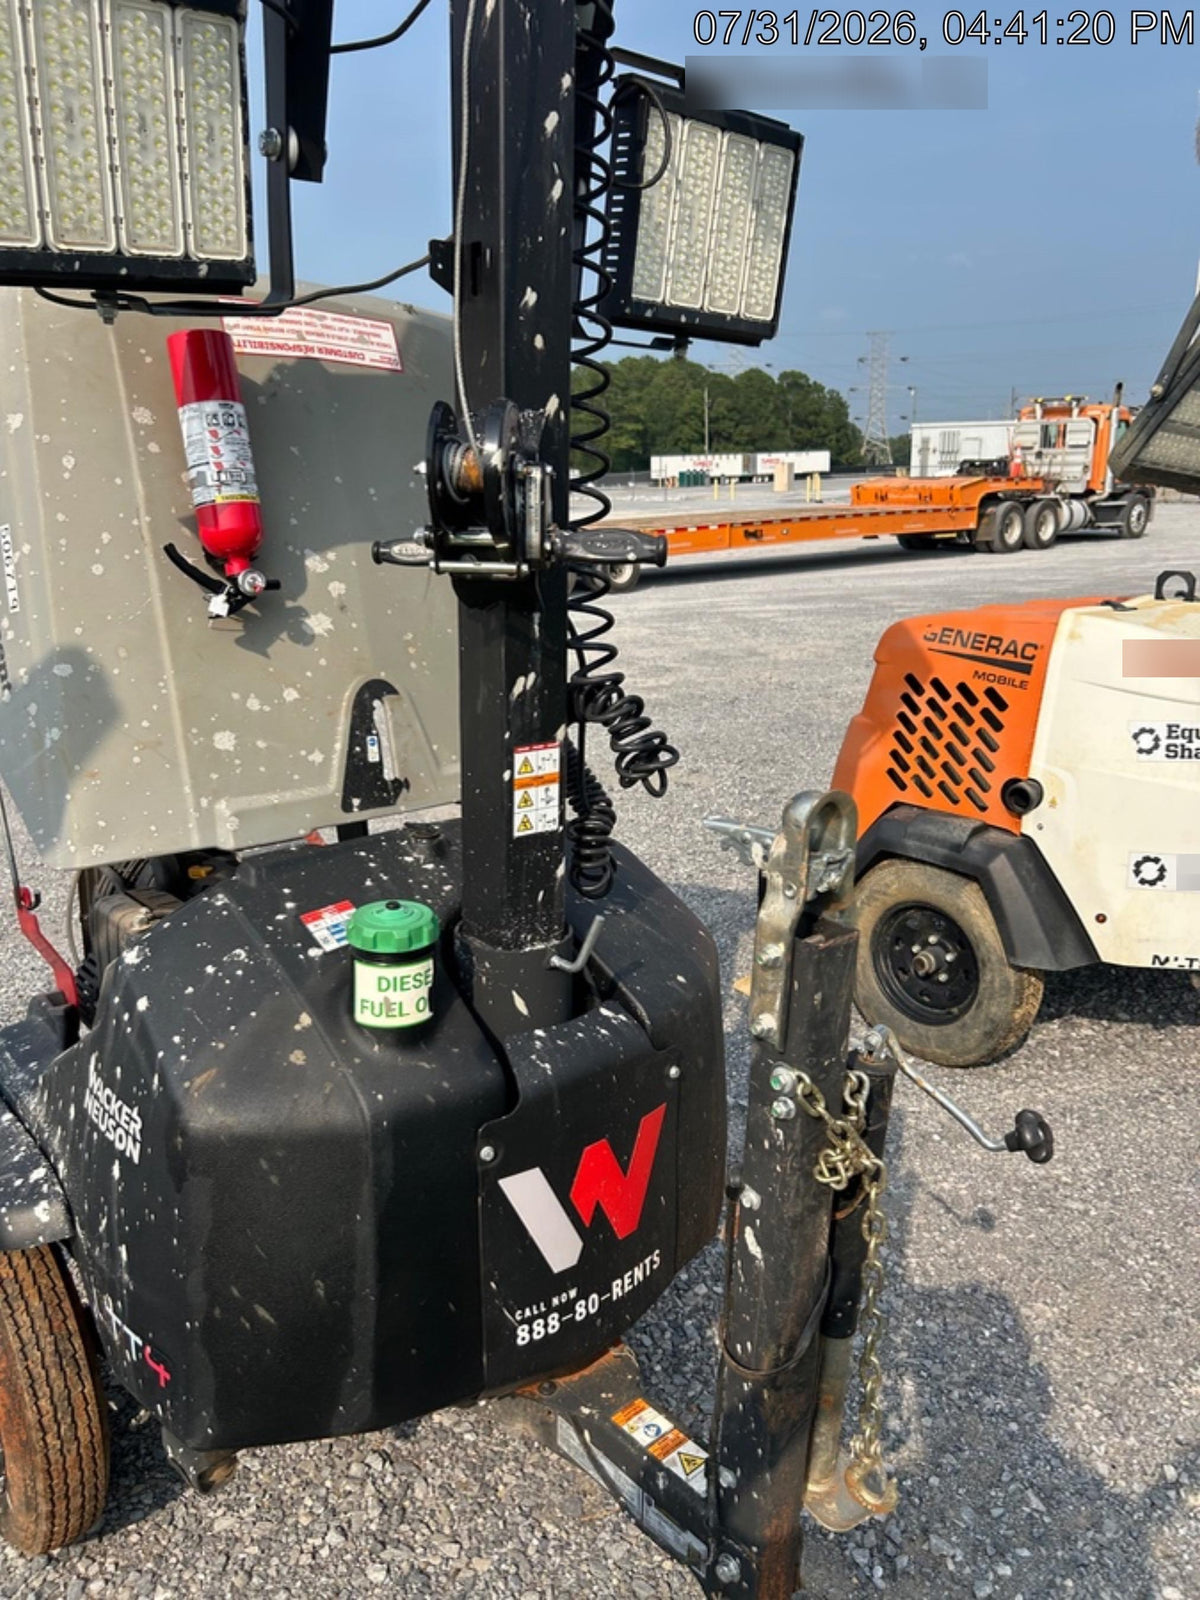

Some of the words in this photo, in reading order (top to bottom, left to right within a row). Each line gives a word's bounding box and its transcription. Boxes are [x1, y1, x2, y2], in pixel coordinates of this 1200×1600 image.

[234, 338, 315, 355] RESPONSIBILIT
[316, 344, 366, 361] CUSTOMER
[972, 670, 1029, 690] MOBILE
[360, 998, 411, 1018] FUEL
[88, 1054, 142, 1142] WACKER
[83, 1087, 141, 1165] NEUSON
[515, 1302, 547, 1321] CALL
[552, 1287, 578, 1307] NOW
[516, 1249, 661, 1346] 888-80-RENTS
